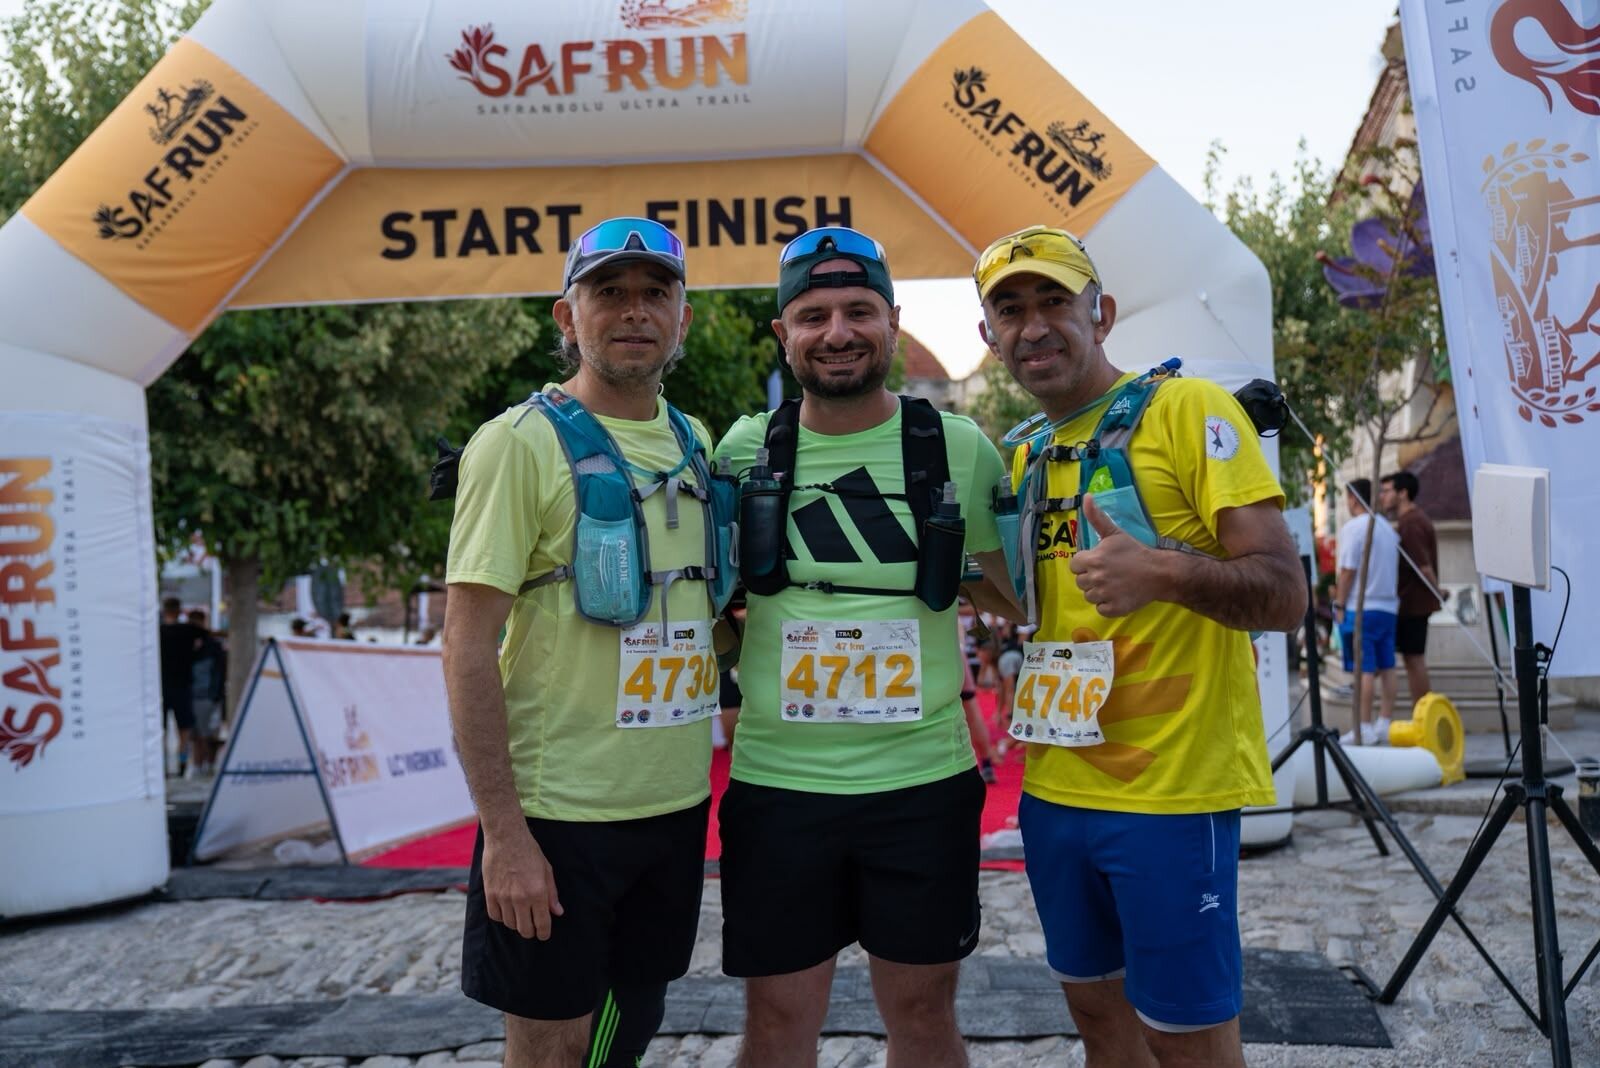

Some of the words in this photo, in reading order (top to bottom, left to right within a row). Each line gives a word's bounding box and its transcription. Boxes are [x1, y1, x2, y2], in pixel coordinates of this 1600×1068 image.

[477, 102, 605, 116] SAFRANBOLU
[620, 98, 681, 111] ULTRA
[696, 93, 751, 106] TRAIL
[381, 204, 582, 260] START
[1037, 519, 1078, 551] SA
[624, 653, 719, 704] 4730
[786, 653, 917, 700] 4712
[1017, 672, 1107, 722] 4746
